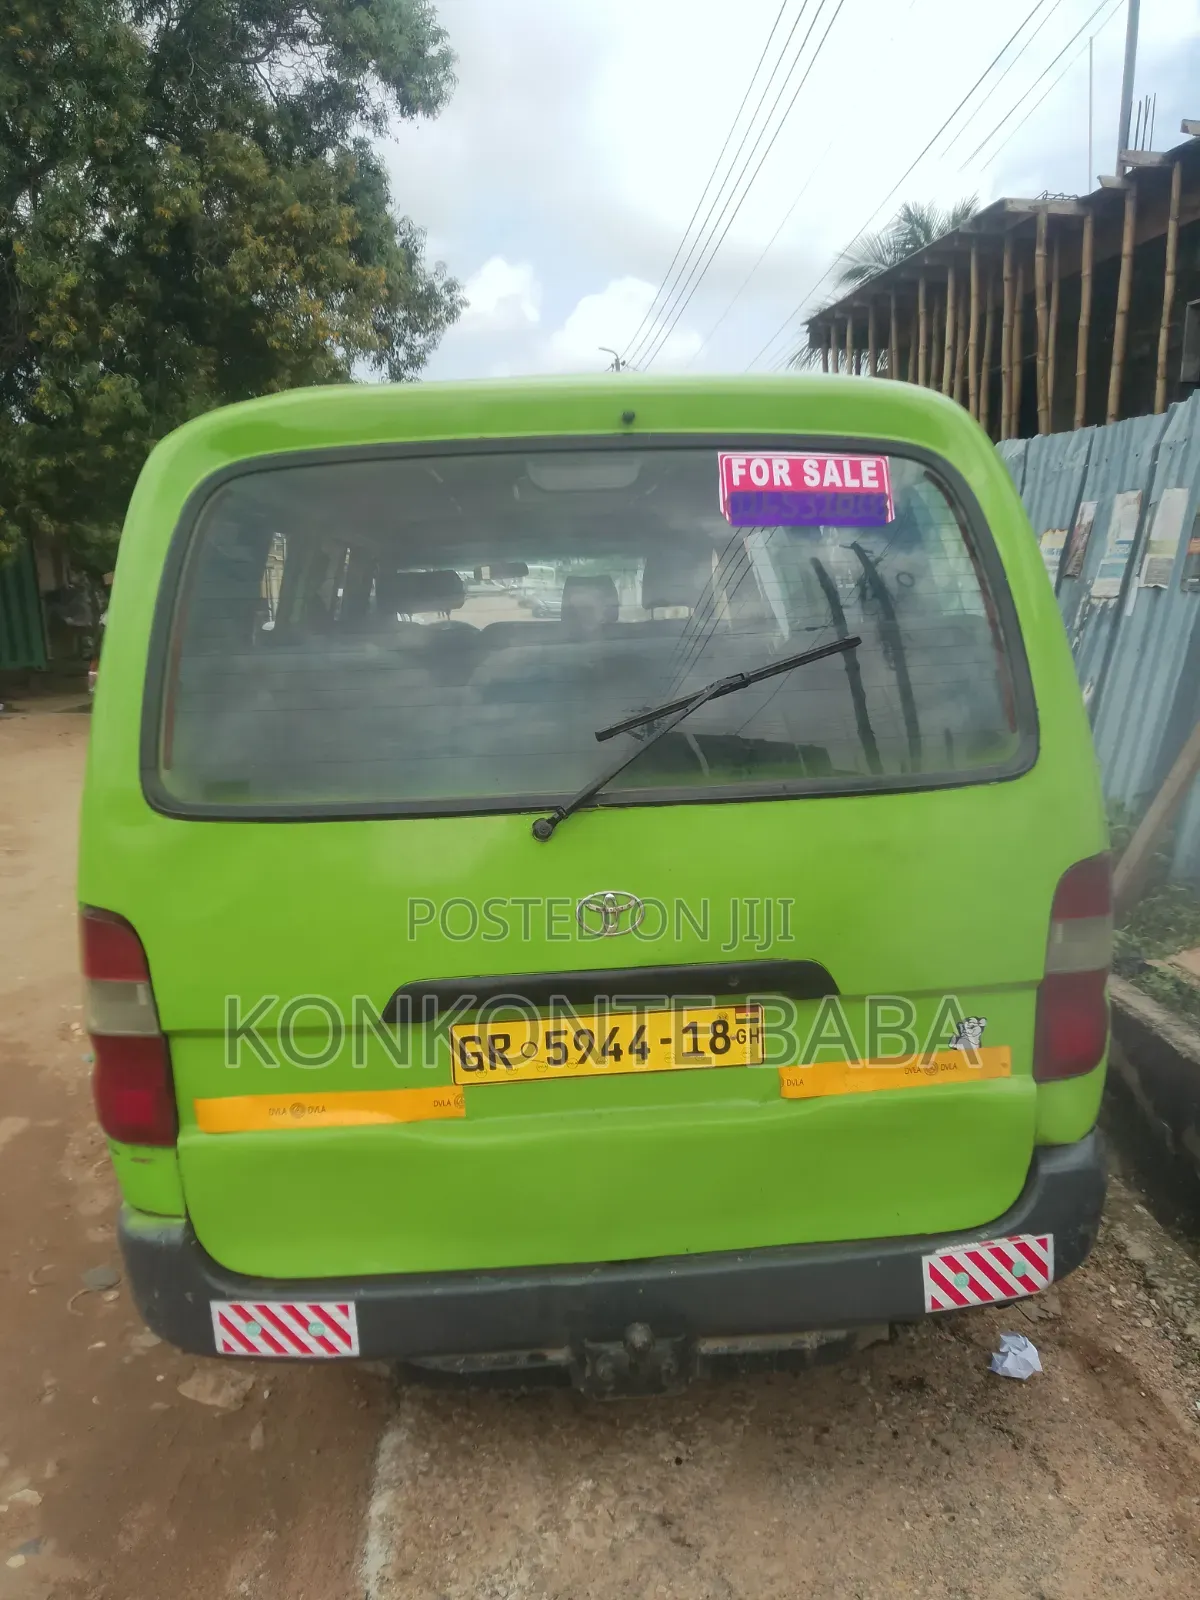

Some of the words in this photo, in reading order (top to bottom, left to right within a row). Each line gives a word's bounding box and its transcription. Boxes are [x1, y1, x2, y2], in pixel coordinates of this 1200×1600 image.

[731, 458, 793, 487] FOR
[802, 458, 880, 488] SALE
[736, 1028, 760, 1045] GH
[459, 1033, 513, 1073] GR
[940, 1062, 958, 1071] DVLA
[786, 1078, 804, 1087] DVLA
[433, 1099, 451, 1107] DVLA
